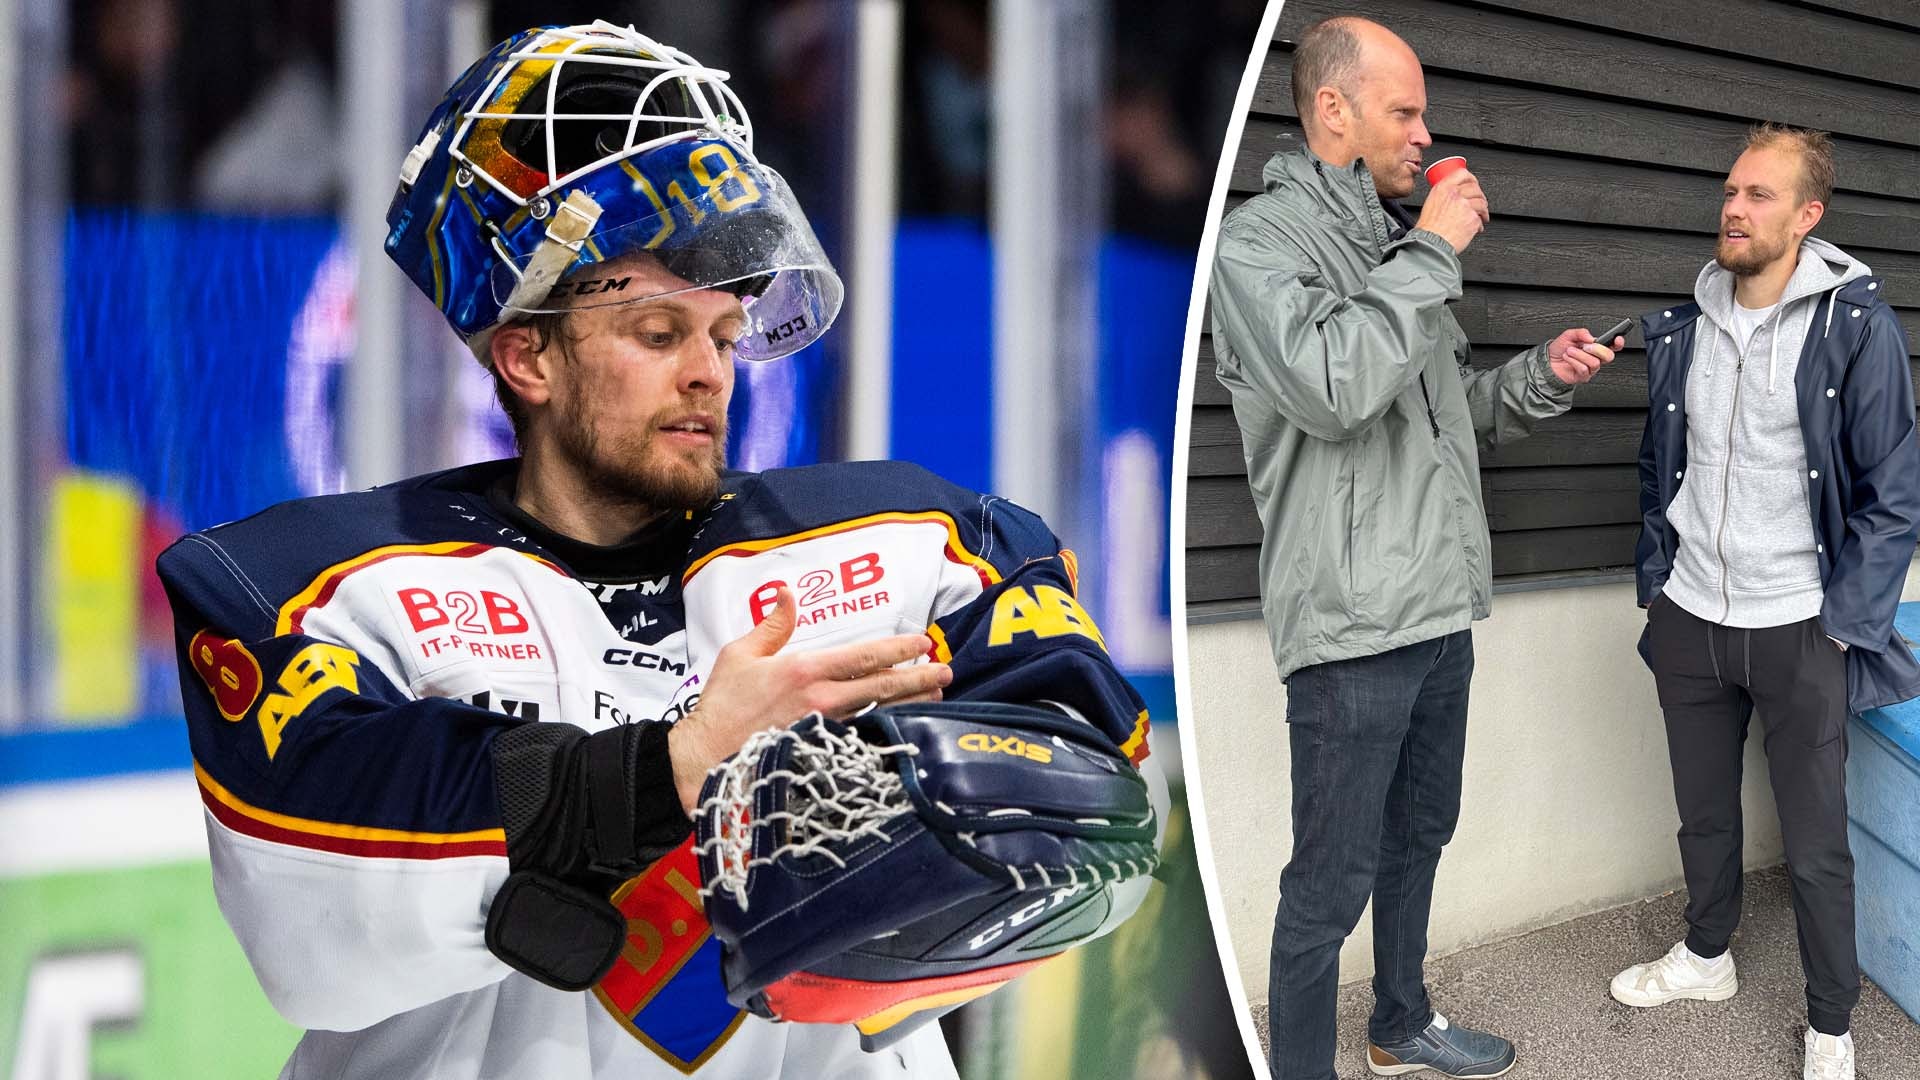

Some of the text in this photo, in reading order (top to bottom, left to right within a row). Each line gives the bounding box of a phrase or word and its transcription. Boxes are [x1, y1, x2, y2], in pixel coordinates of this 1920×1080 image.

[667, 143, 760, 226] 18
[551, 276, 632, 298] CCM
[397, 587, 529, 635] B2B
[616, 610, 659, 639] HL
[796, 591, 890, 628] ARTNER
[420, 634, 542, 660] IT-PRTNER
[602, 648, 686, 677] CCM
[957, 732, 1053, 765] axis
